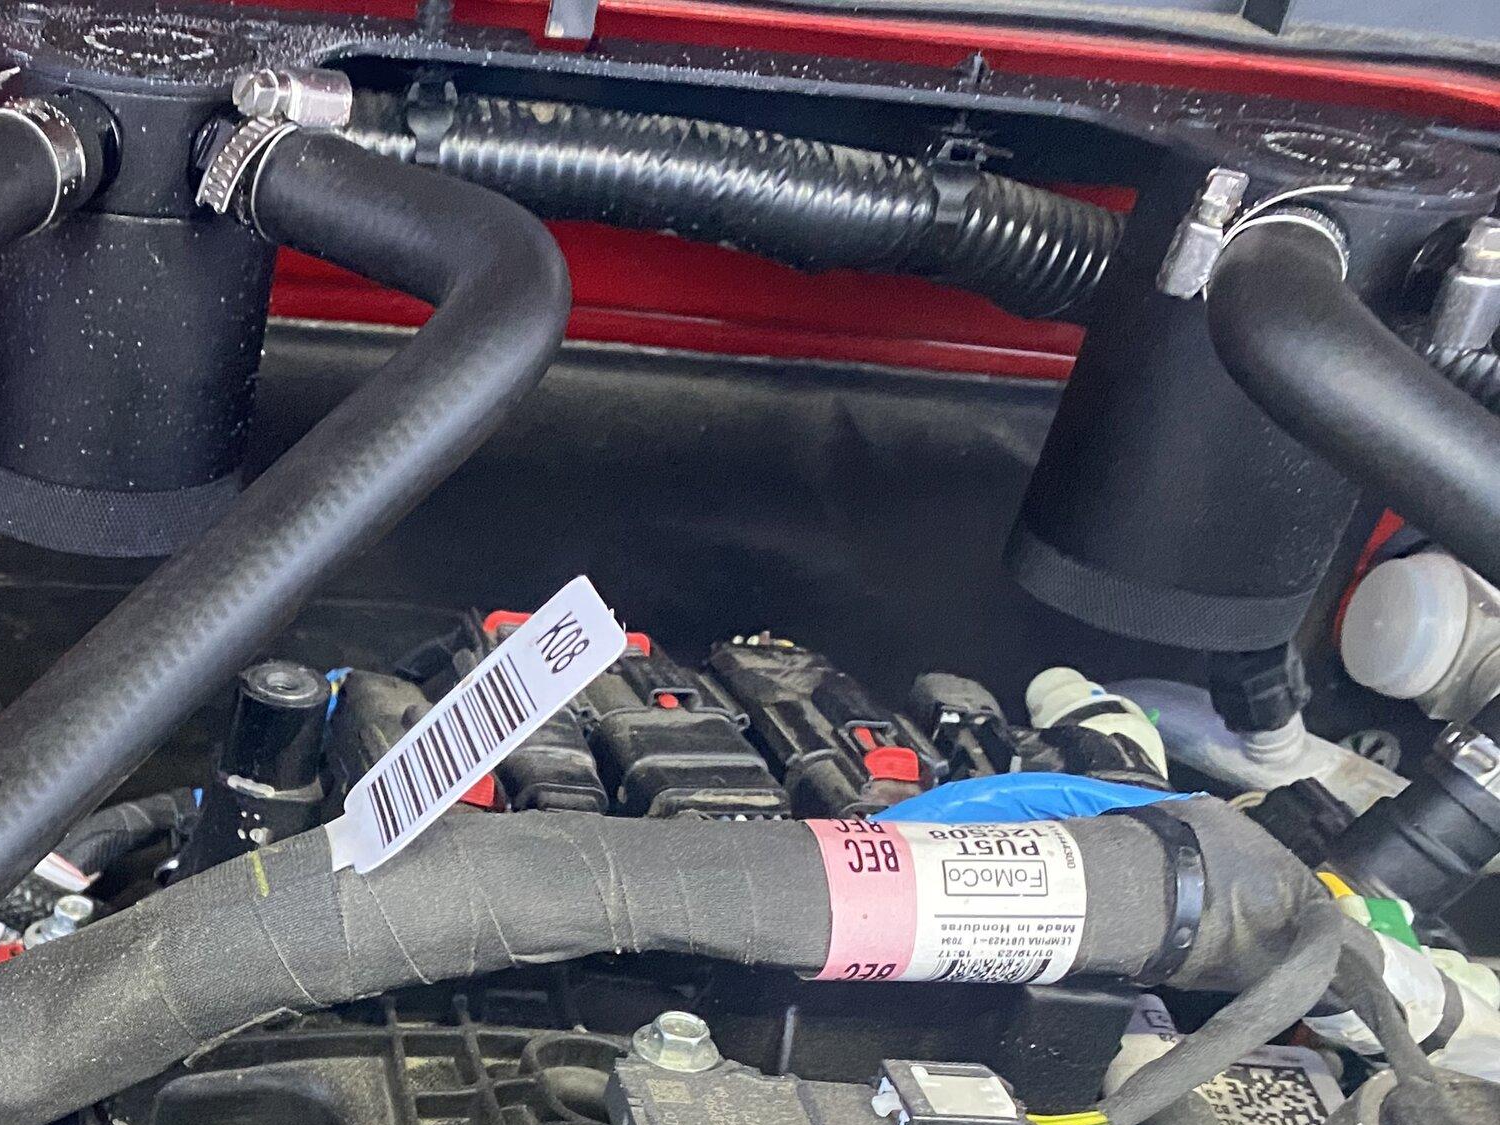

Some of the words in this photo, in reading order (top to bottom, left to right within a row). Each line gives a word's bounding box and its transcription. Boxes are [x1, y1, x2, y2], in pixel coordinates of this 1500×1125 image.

[536, 610, 590, 674] K08
[844, 839, 900, 873] BEC
[956, 839, 1040, 856] PU5T
[948, 868, 1042, 888] FoMoCo
[941, 923, 1010, 933] Honduras
[1037, 924, 1075, 933] Made
